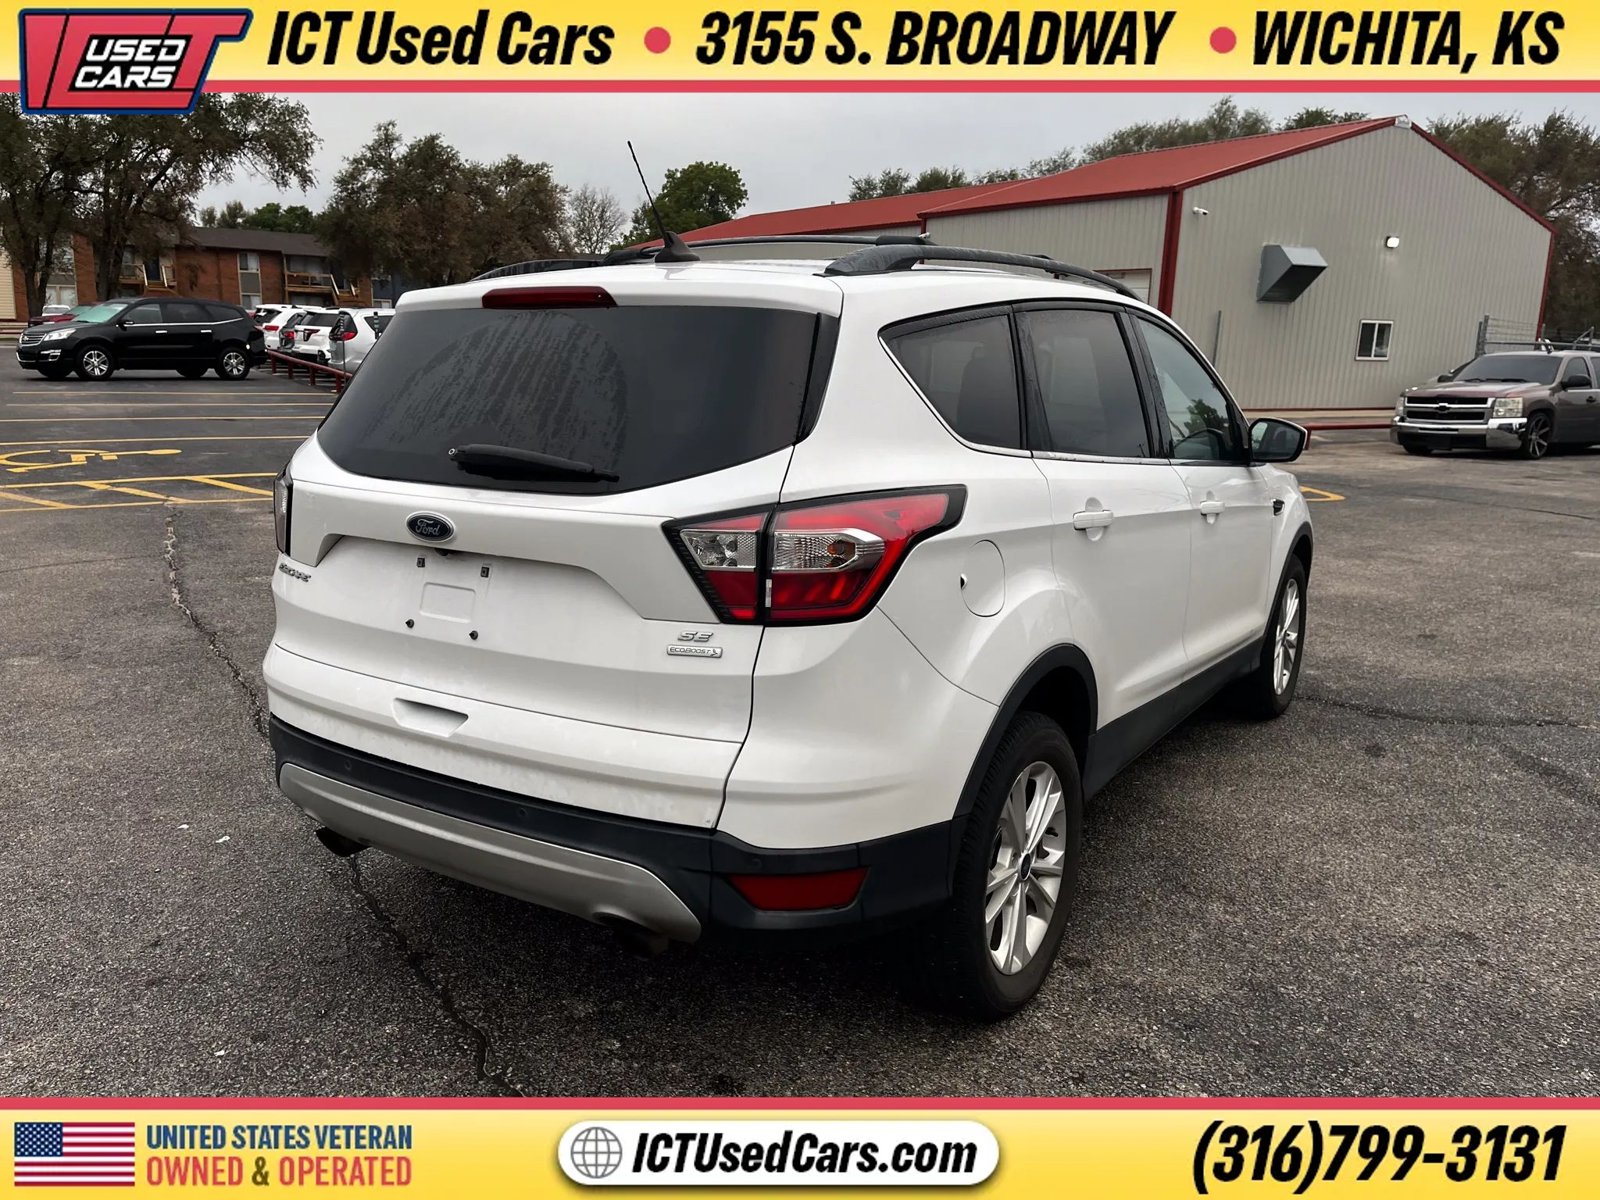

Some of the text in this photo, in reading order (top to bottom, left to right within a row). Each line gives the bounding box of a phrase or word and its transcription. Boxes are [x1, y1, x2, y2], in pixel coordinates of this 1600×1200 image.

[415, 518, 441, 536] Ford
[677, 631, 714, 643] SE
[669, 646, 711, 654] ECOBOOST
